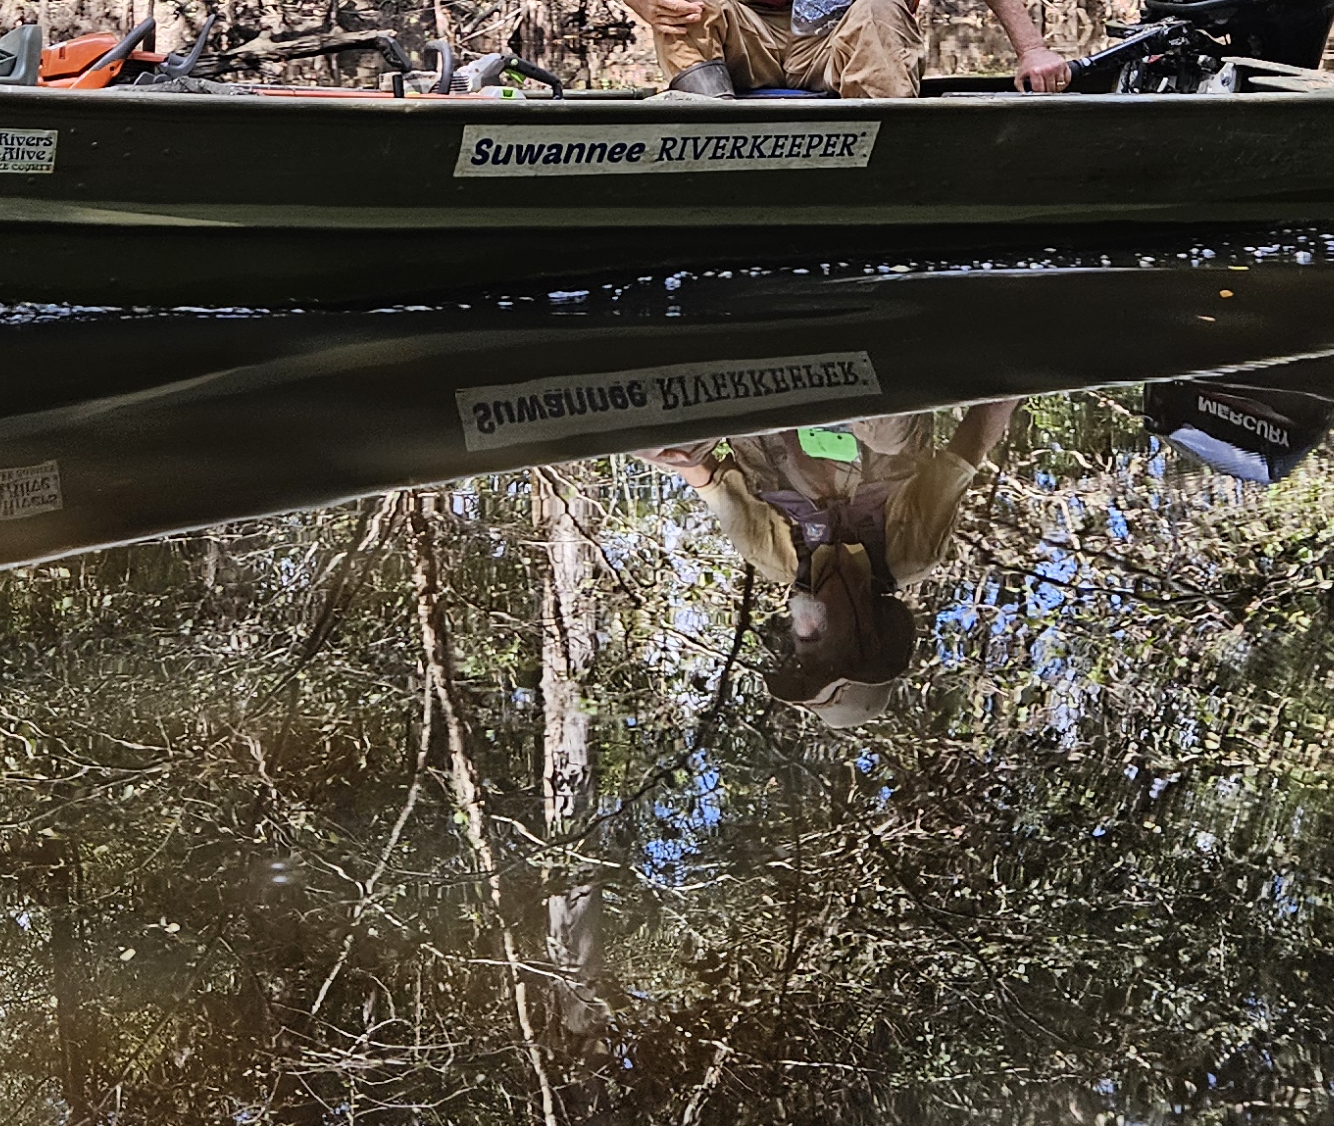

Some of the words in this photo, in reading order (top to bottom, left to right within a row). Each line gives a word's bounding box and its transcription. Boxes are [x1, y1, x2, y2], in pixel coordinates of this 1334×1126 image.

[1, 147, 47, 161] Alive
[470, 137, 647, 166] Suwannee
[654, 133, 858, 162] RIVERKEEPER
